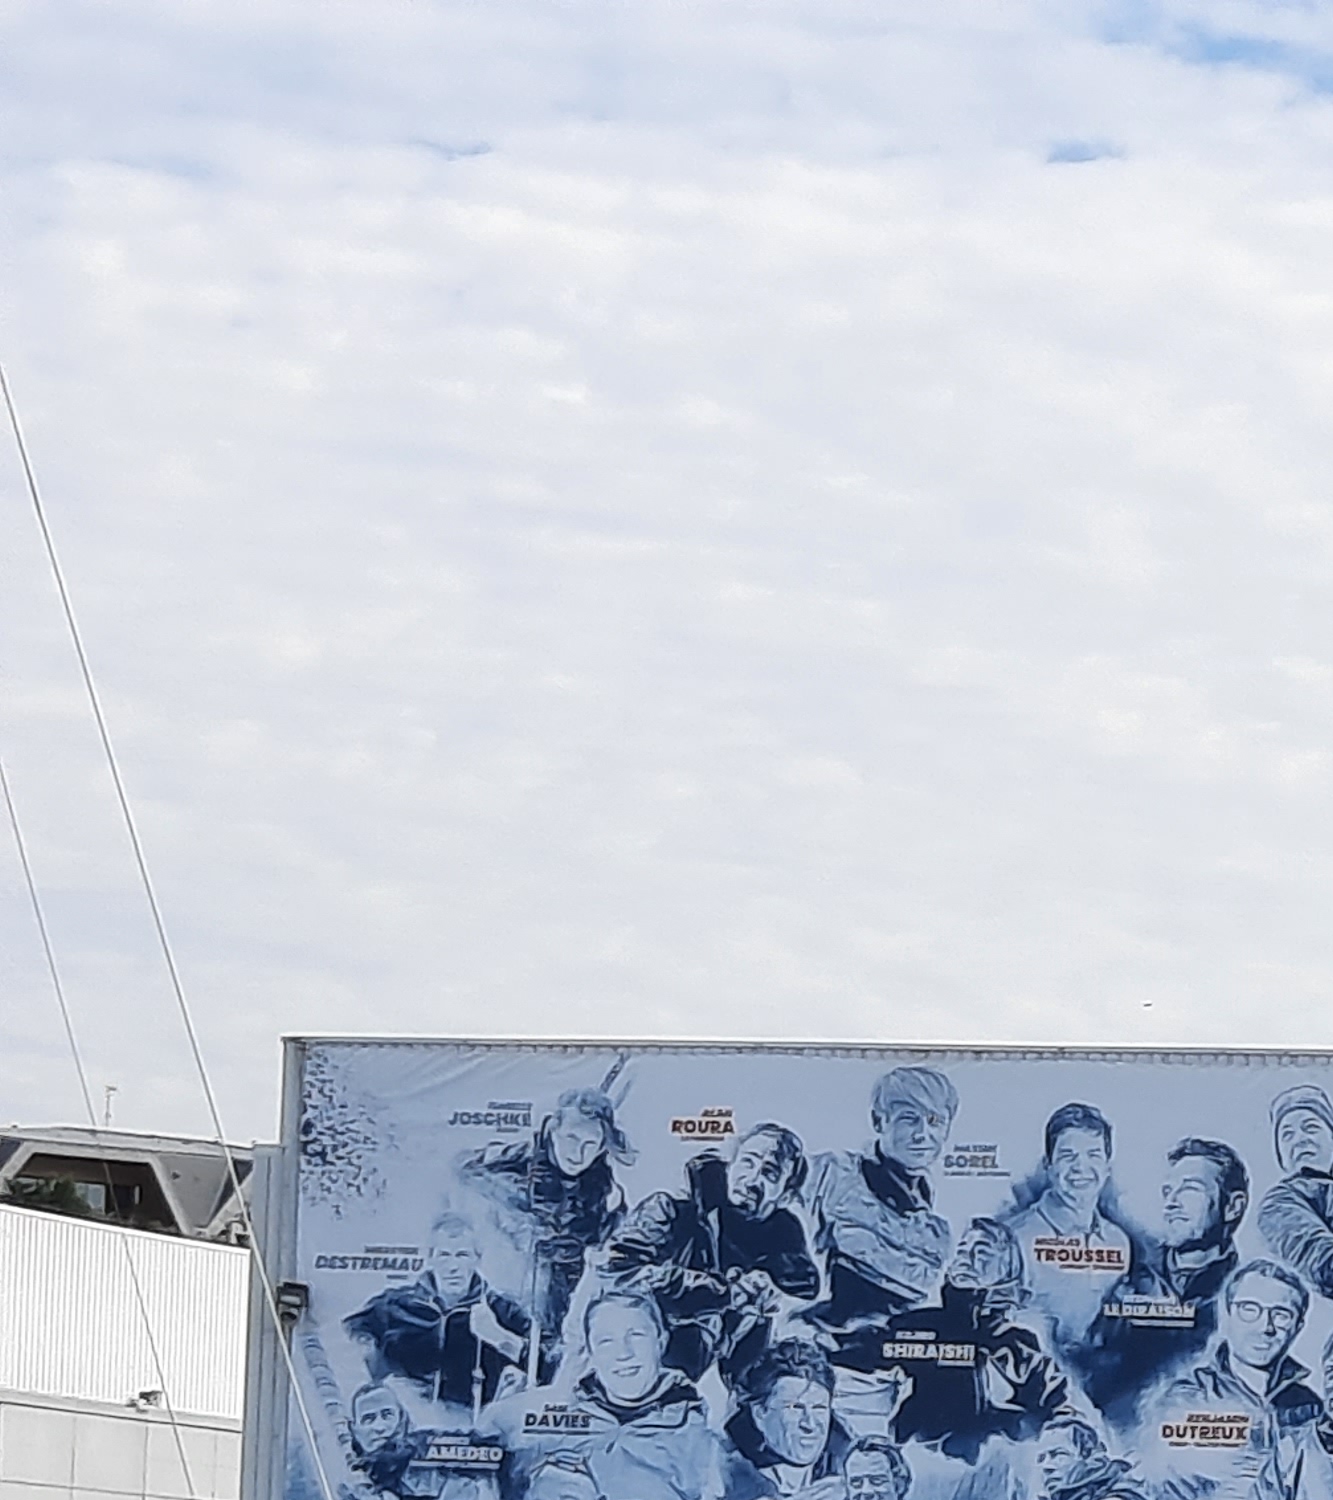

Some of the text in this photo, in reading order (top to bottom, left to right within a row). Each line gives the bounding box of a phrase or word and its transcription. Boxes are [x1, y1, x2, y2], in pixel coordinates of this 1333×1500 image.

[671, 1119, 735, 1134] ROURA
[1034, 1248, 1124, 1263] TROUSSEL
[524, 1413, 591, 1428] DAVIES
[1162, 1425, 1247, 1440] DUTREUX
